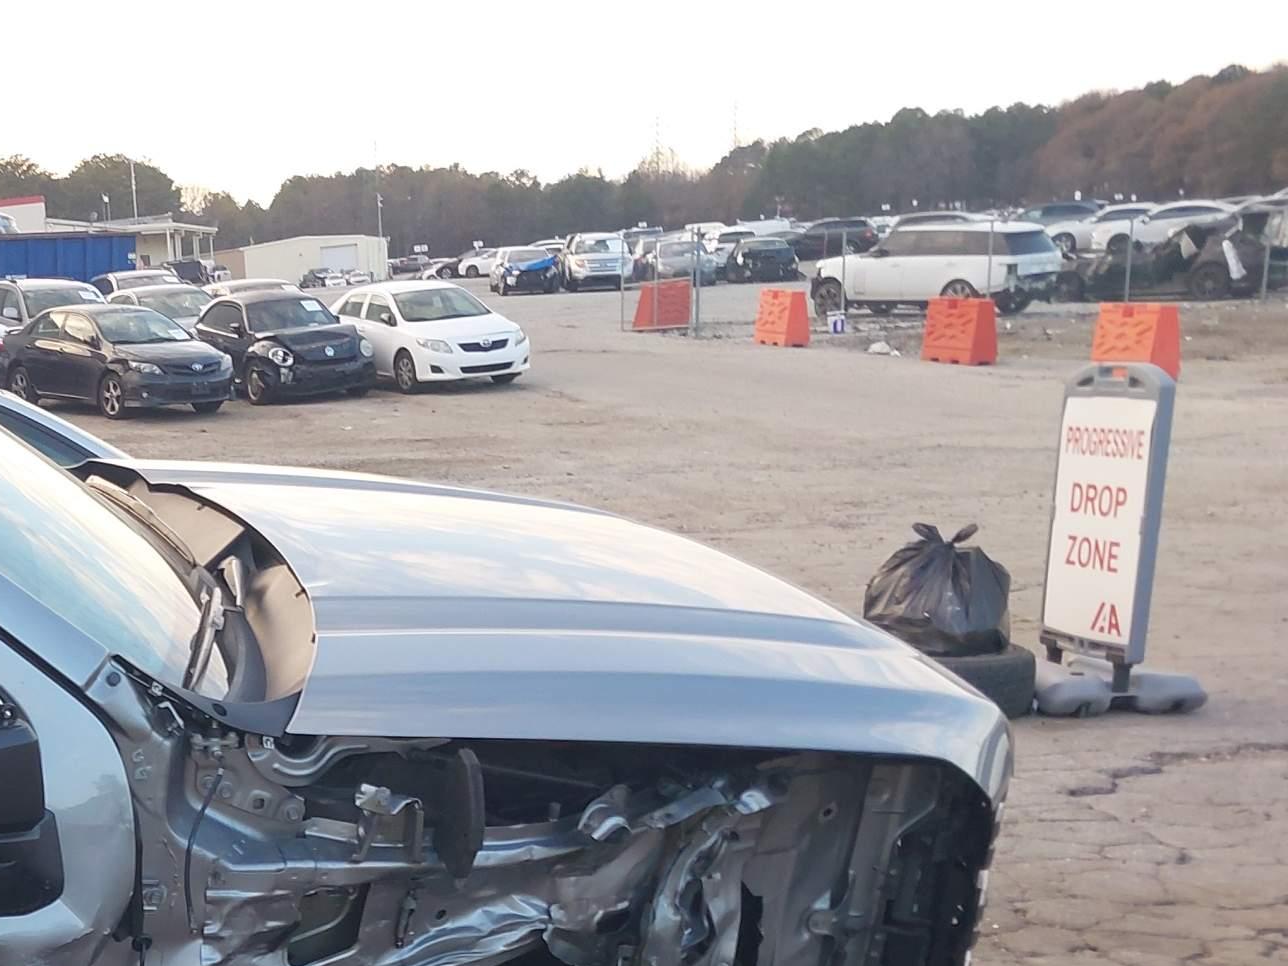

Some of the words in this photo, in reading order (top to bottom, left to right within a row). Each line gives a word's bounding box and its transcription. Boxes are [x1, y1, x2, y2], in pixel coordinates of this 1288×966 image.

[1065, 426, 1145, 460] PROGRESSIVE
[1069, 482, 1128, 518] DROP
[1065, 534, 1121, 574] ZONE
